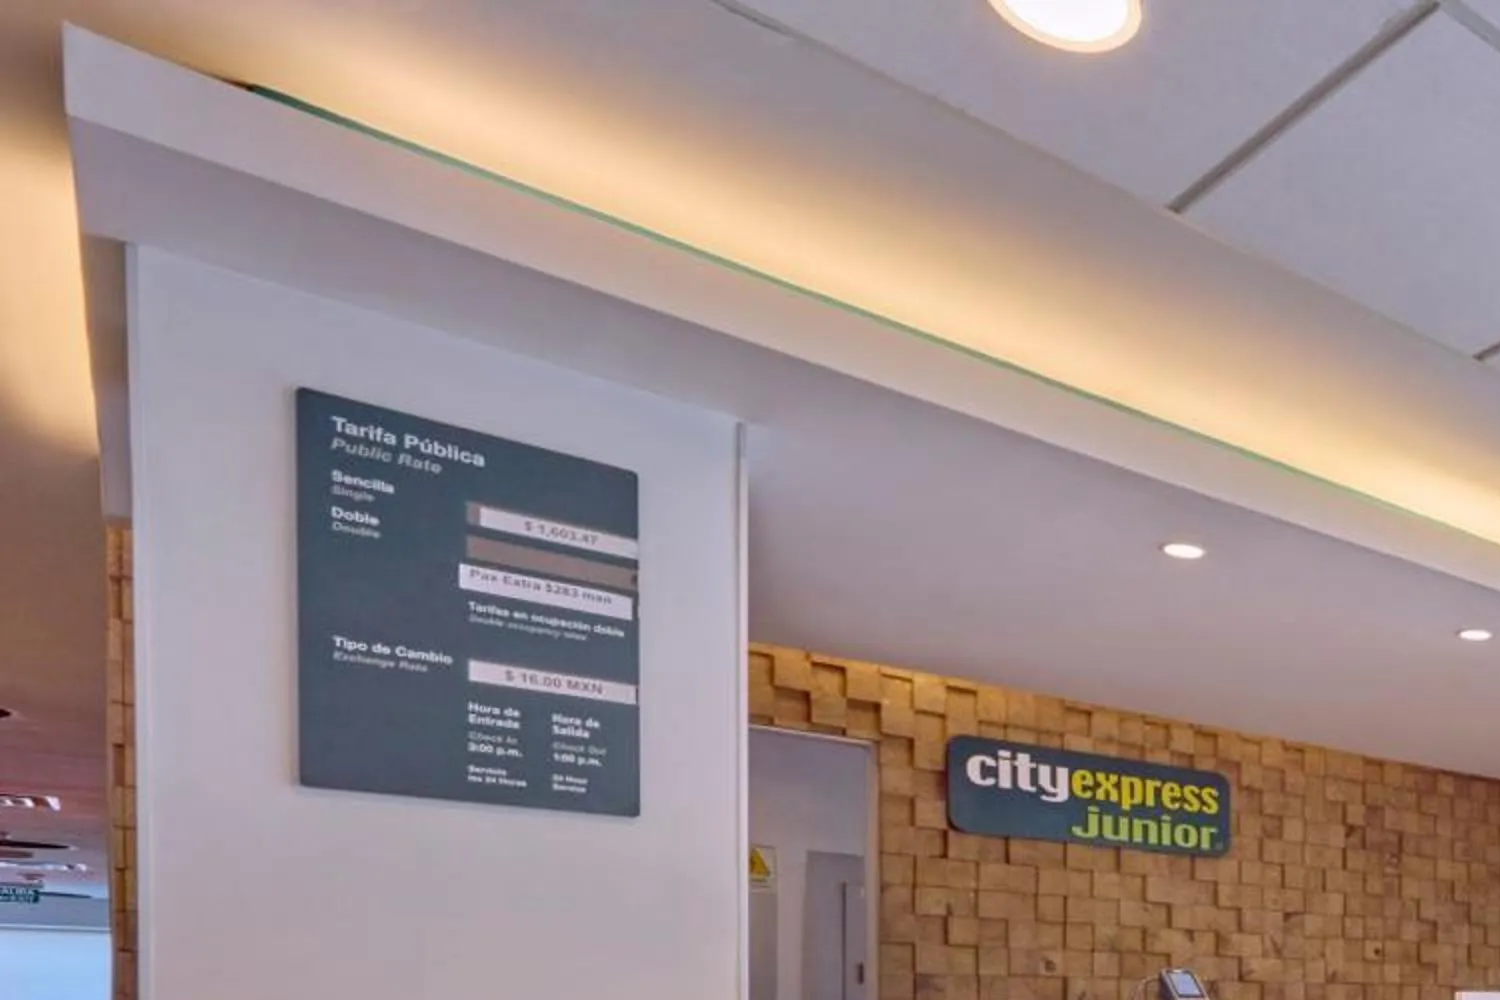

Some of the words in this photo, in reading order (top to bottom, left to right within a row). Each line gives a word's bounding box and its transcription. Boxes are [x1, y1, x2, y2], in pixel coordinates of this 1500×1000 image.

[330, 415, 397, 446] Tarifa
[403, 433, 485, 468] Pública
[331, 437, 393, 463] Public
[397, 453, 443, 475] Rate
[331, 469, 395, 495] Sencilla
[331, 484, 376, 502] Single
[331, 505, 381, 526] Doble
[331, 520, 382, 539] Double
[469, 568, 499, 582] Pax
[502, 574, 542, 592] Extra
[332, 635, 368, 653] Tipo
[371, 641, 391, 656] de
[395, 645, 454, 666] Cambio
[332, 650, 395, 670] Exchange
[505, 669, 515, 682] $
[566, 677, 604, 695] MXN
[467, 701, 500, 715] Hora
[503, 706, 521, 718] de
[467, 713, 521, 729] Entrada
[551, 713, 582, 726] Hora
[585, 717, 600, 728] de
[552, 725, 590, 739] Salida
[1071, 805, 1219, 850] junior
